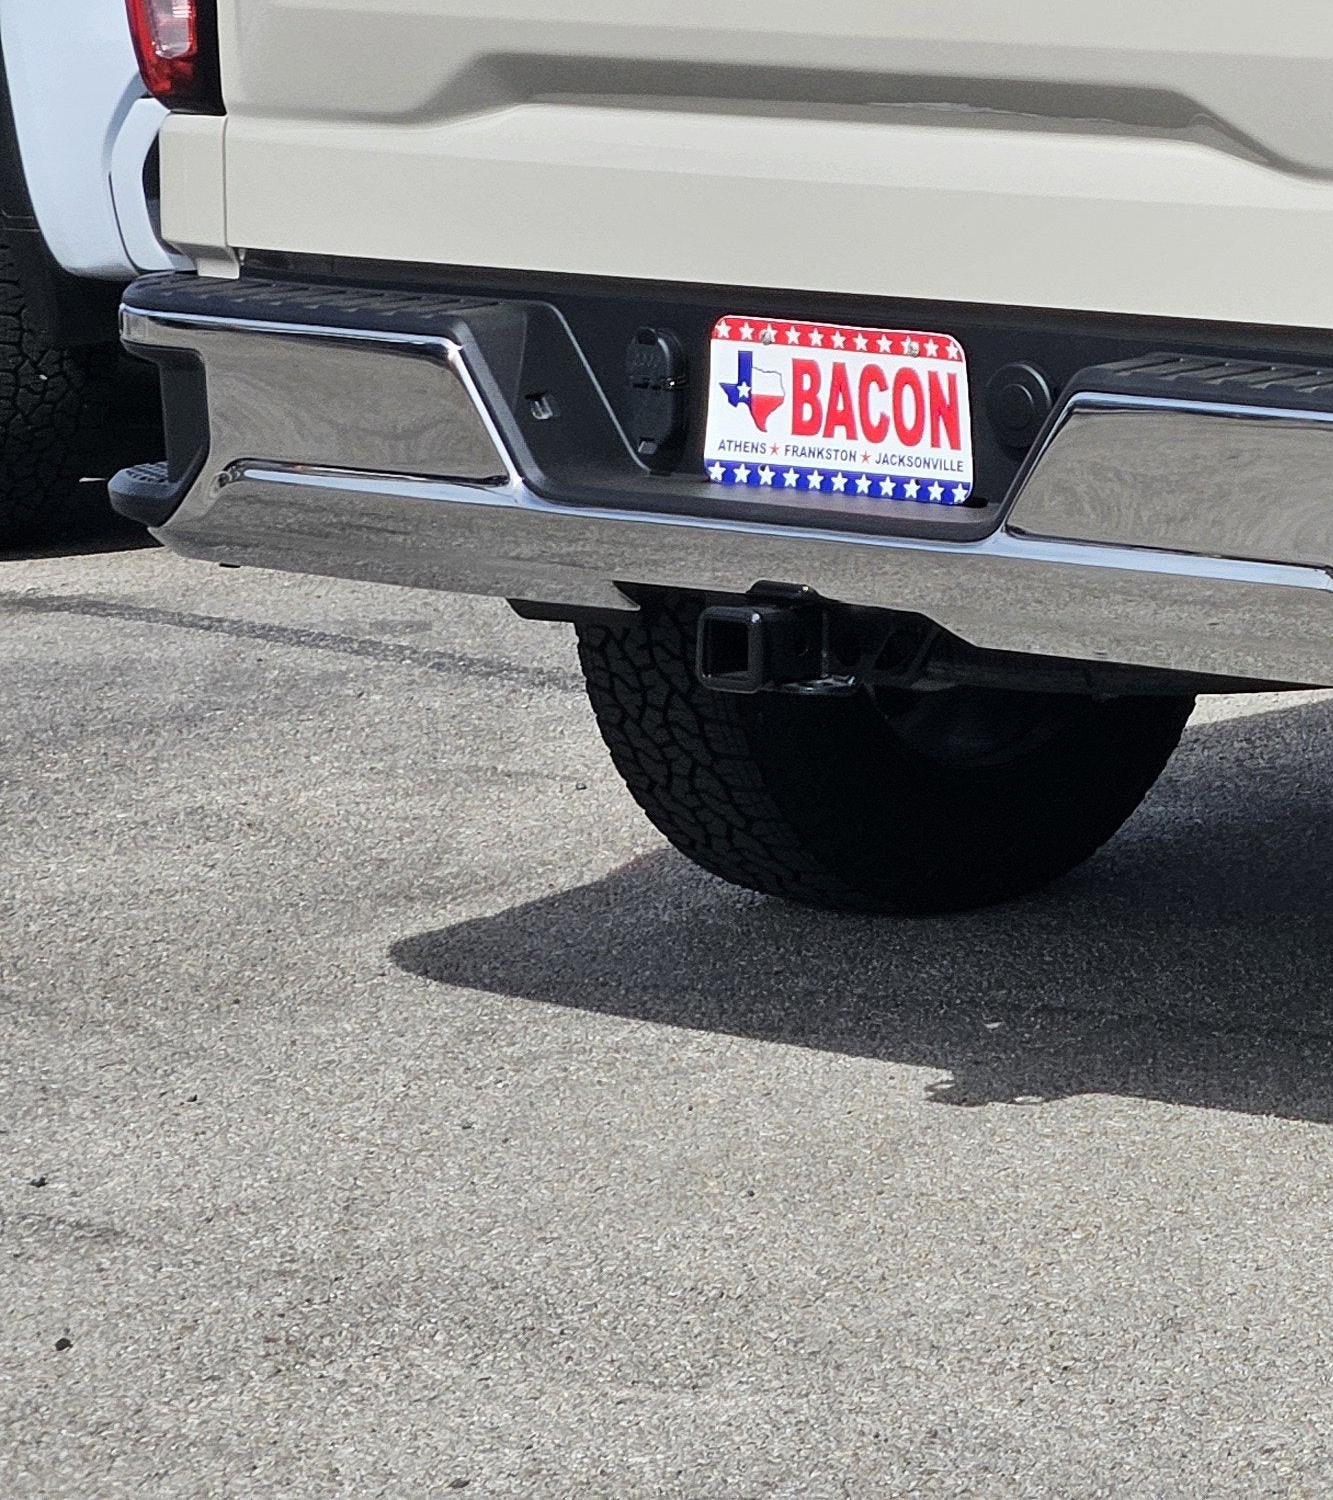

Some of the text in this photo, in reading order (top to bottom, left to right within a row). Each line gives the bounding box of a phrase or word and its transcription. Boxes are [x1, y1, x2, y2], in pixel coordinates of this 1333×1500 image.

[791, 357, 962, 451] BACON
[717, 438, 964, 473] ATHENS FRANKSTON JACKSONVILLE
